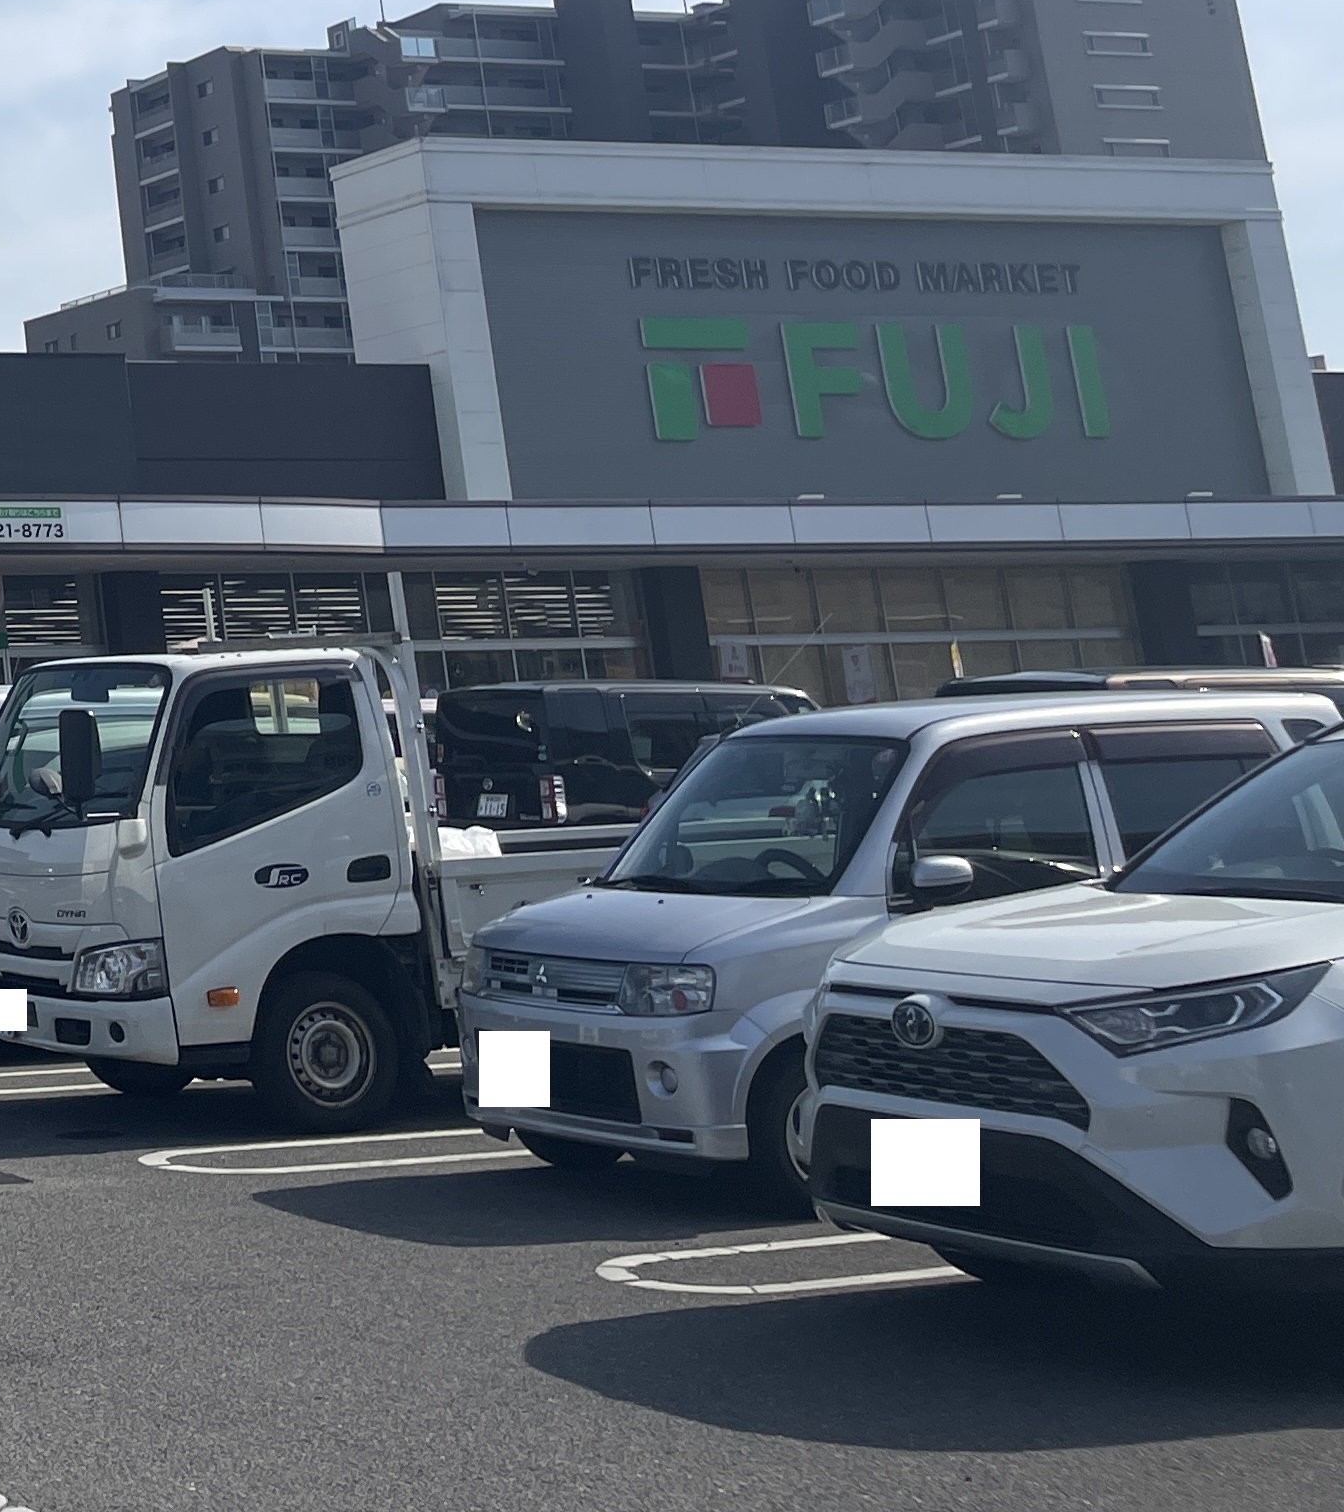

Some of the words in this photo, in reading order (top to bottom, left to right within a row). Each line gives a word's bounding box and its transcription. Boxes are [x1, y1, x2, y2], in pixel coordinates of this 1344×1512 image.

[626, 256, 770, 289] FRESH
[785, 259, 902, 291] FOOD
[914, 261, 1081, 295] MARKET
[779, 321, 1111, 440] FUJI
[56, 909, 87, 919] DYNA
